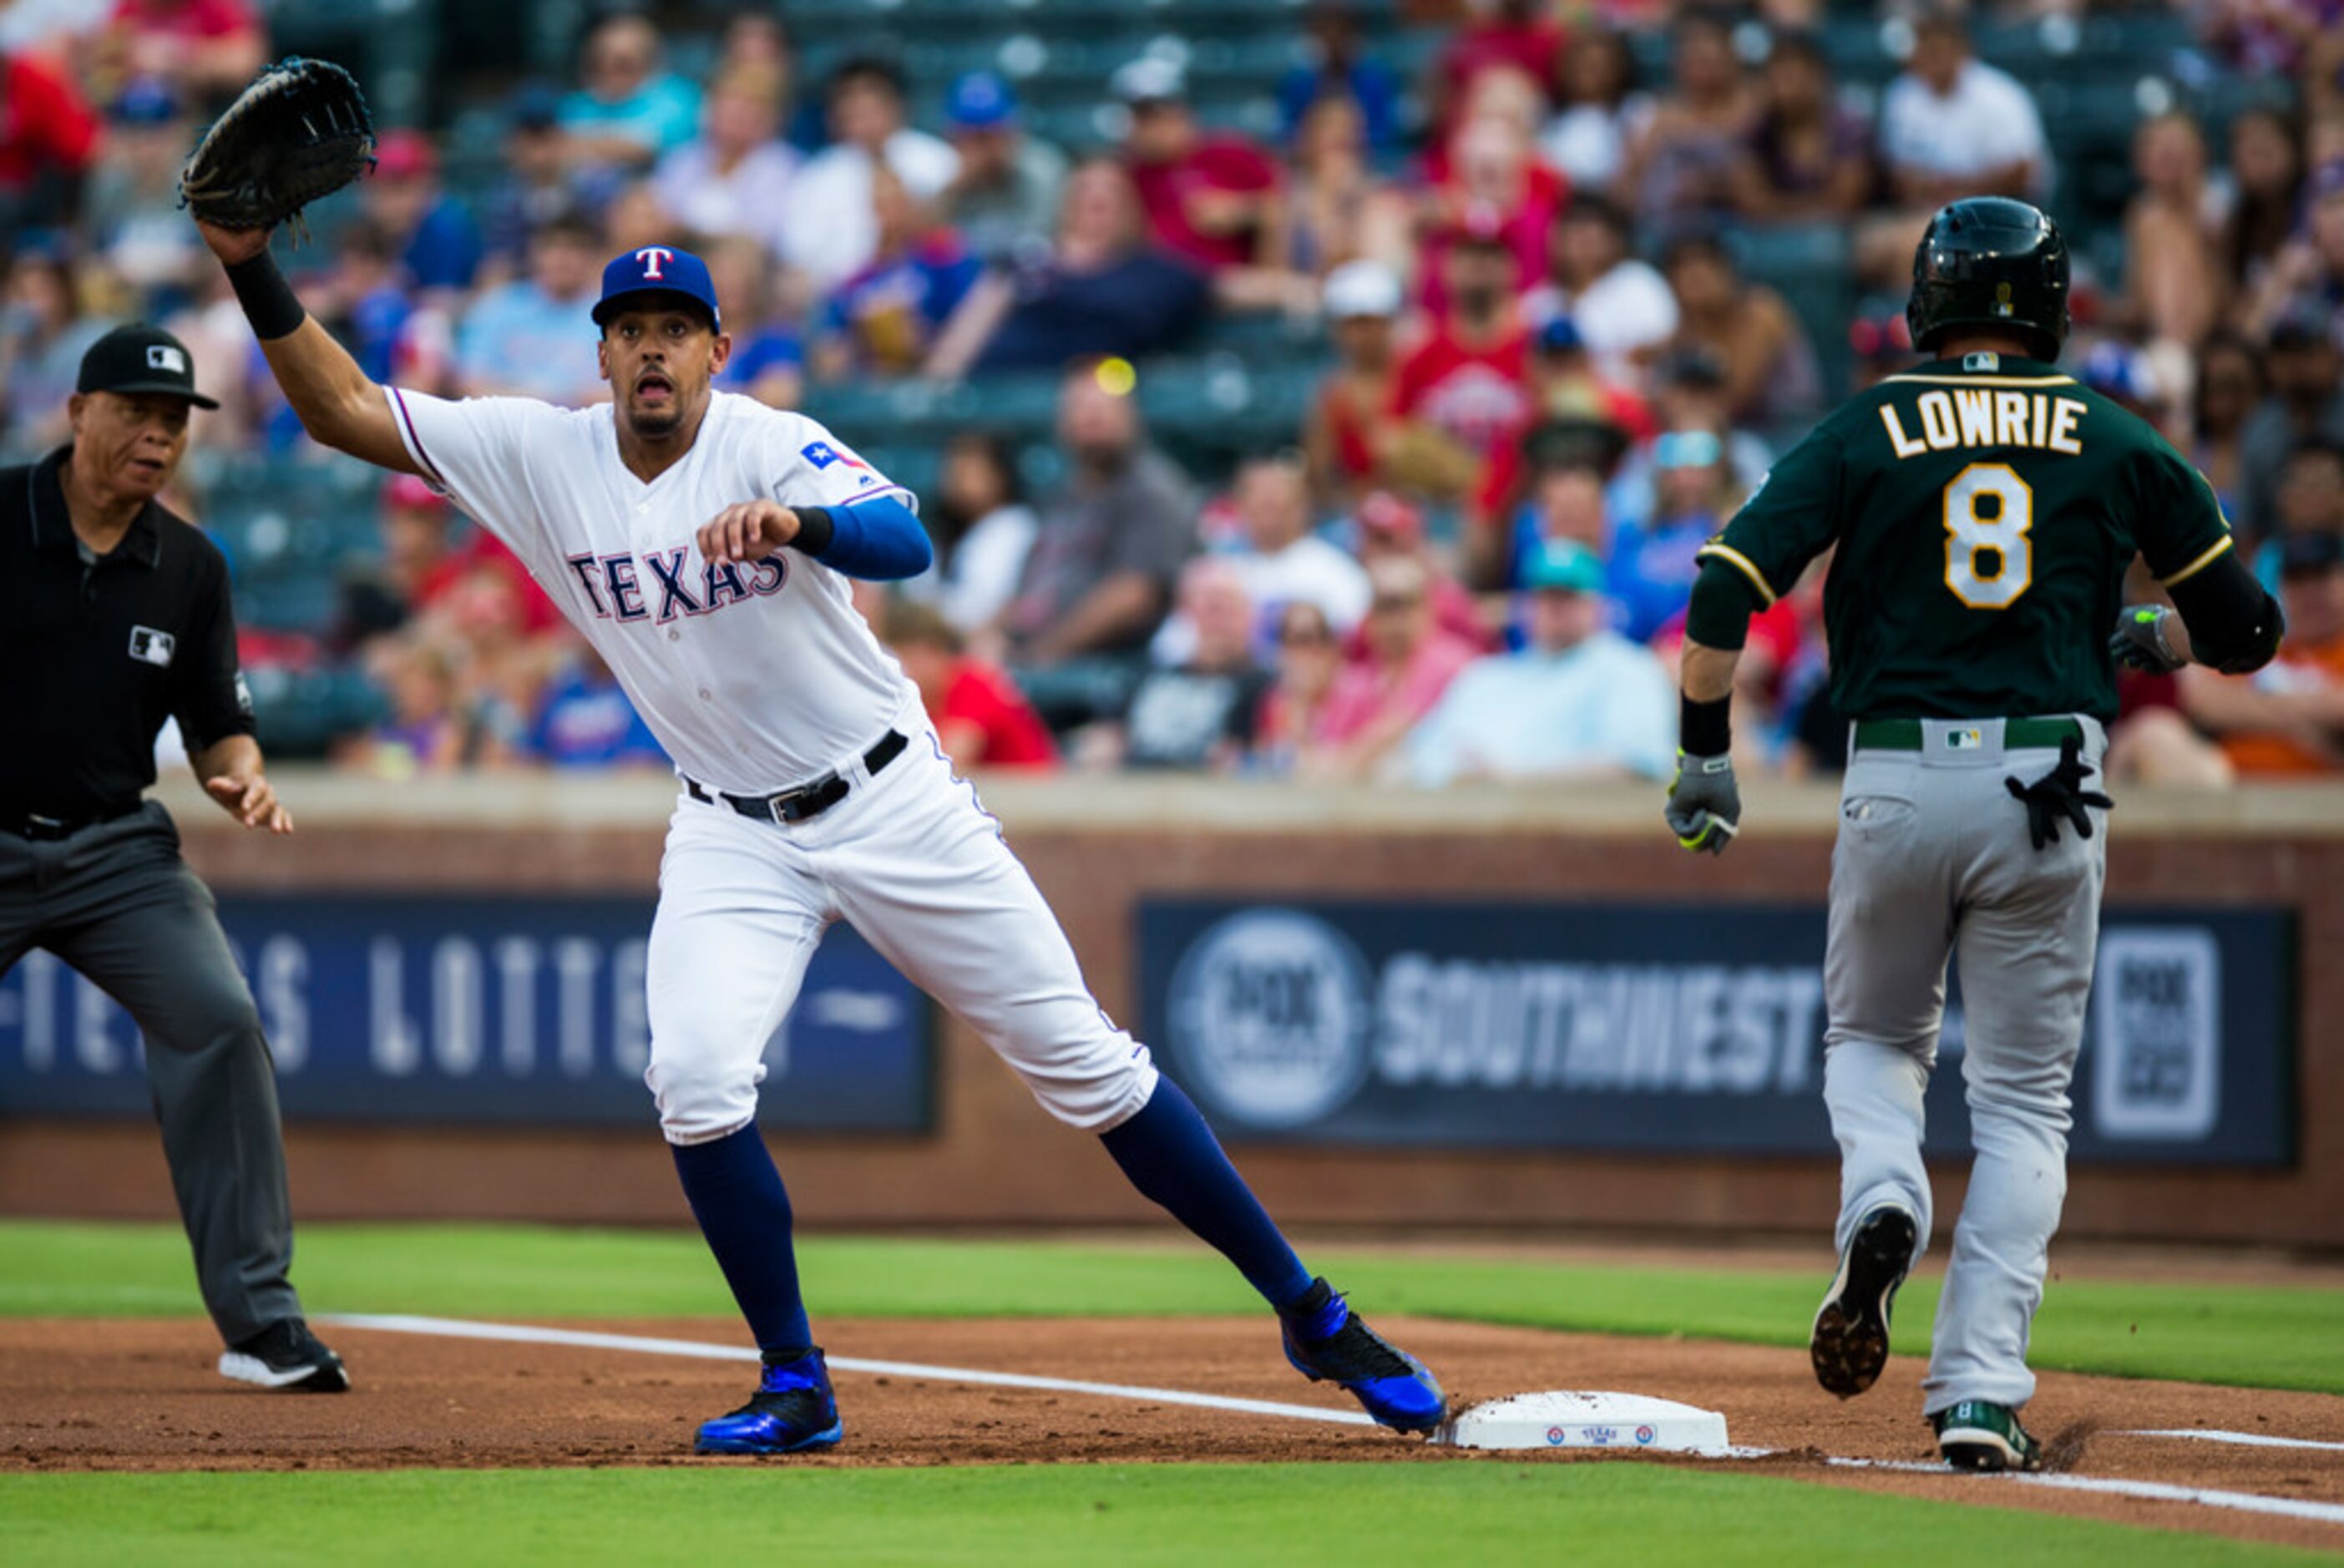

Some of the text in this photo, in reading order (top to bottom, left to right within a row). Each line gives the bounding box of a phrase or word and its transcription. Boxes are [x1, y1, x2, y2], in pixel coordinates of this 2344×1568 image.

[635, 248, 674, 281] T
[1879, 389, 2087, 458] LOWRIE
[1942, 462, 2033, 609] 8
[567, 545, 789, 626] TEXAS
[1376, 950, 1823, 1094] SOUTHWEST
